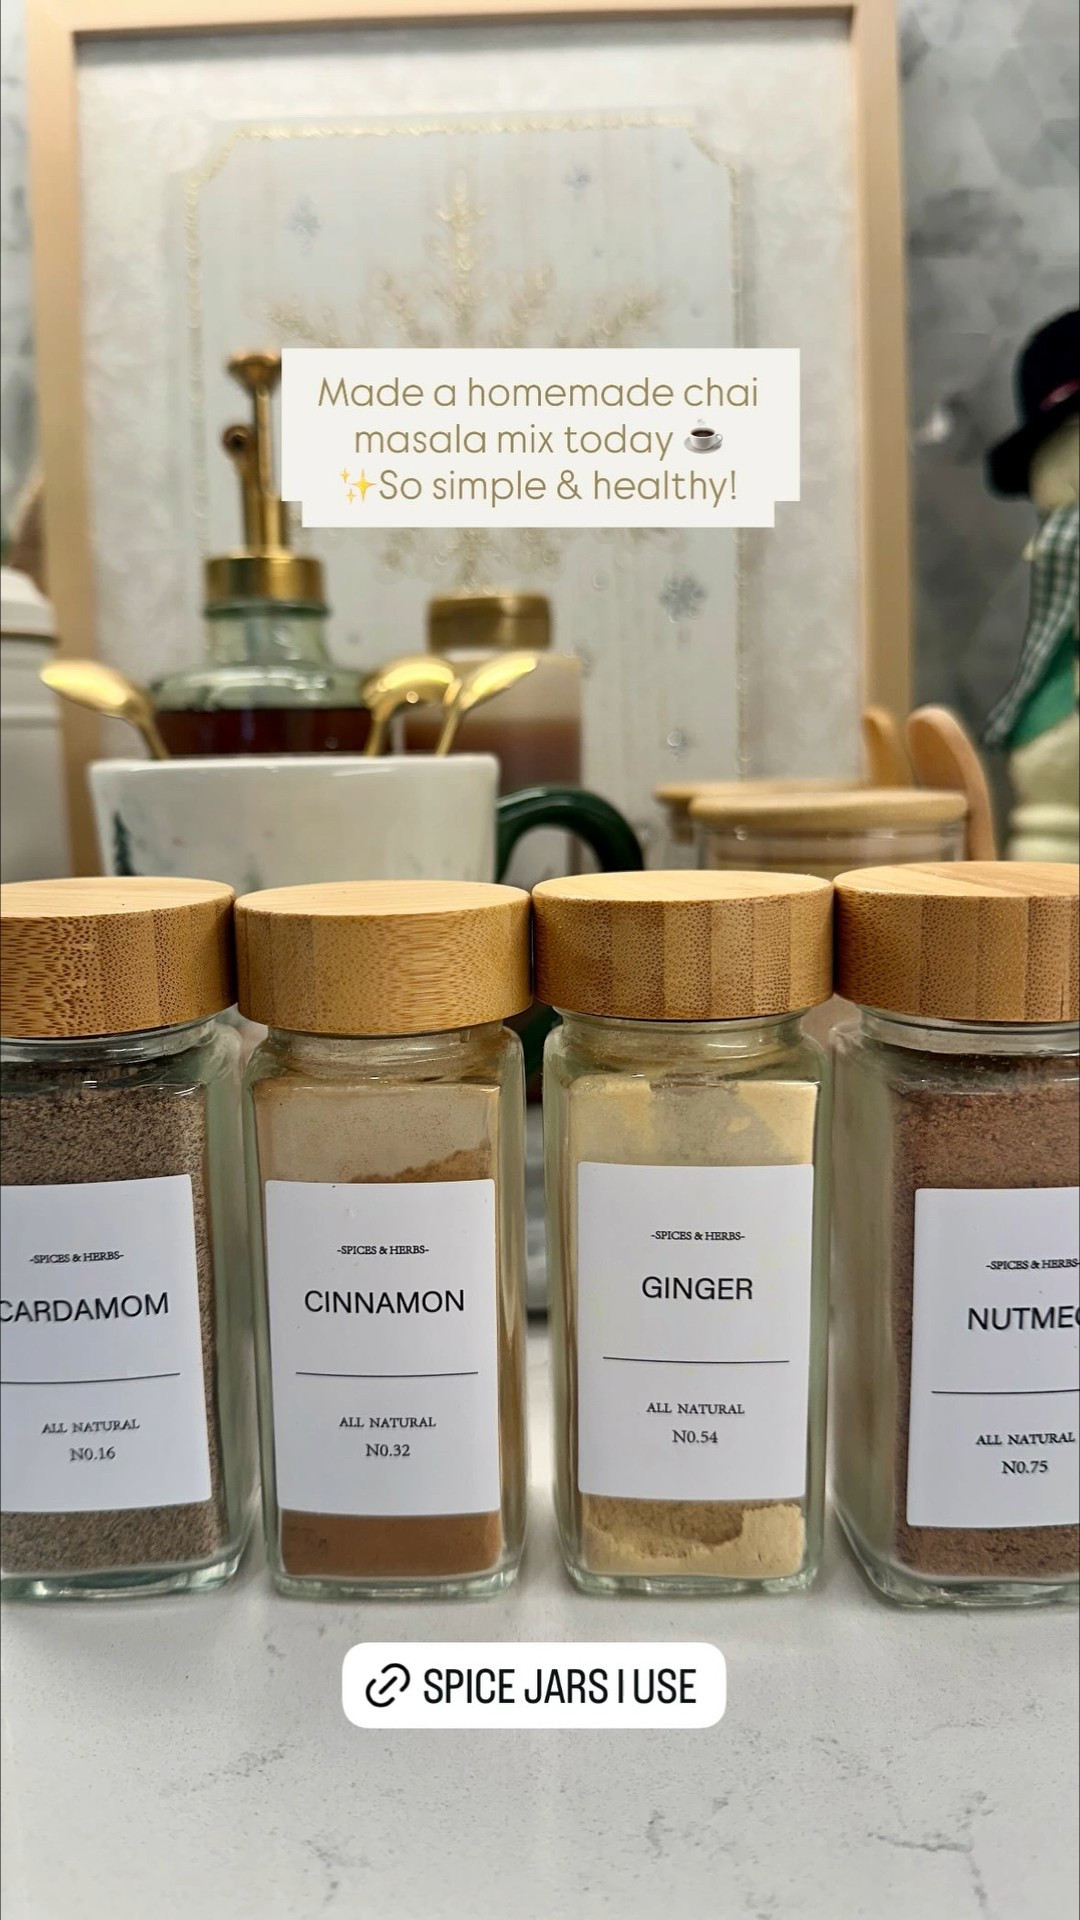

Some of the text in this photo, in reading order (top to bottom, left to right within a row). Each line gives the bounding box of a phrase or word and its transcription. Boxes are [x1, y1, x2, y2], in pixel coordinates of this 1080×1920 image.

[693, 1231, 704, 1241] &
[378, 1245, 388, 1255] &
[71, 1253, 82, 1263] &
[1030, 1259, 1041, 1270] &
[641, 1275, 753, 1301] GINGER
[304, 1289, 464, 1314] CINNAMON
[645, 1402, 746, 1415] ALL NATURAL
[41, 1418, 141, 1435] ALL NATURAL
[338, 1416, 437, 1429] ALL NATURAL
[975, 1431, 1076, 1446] ALL NATURAL
